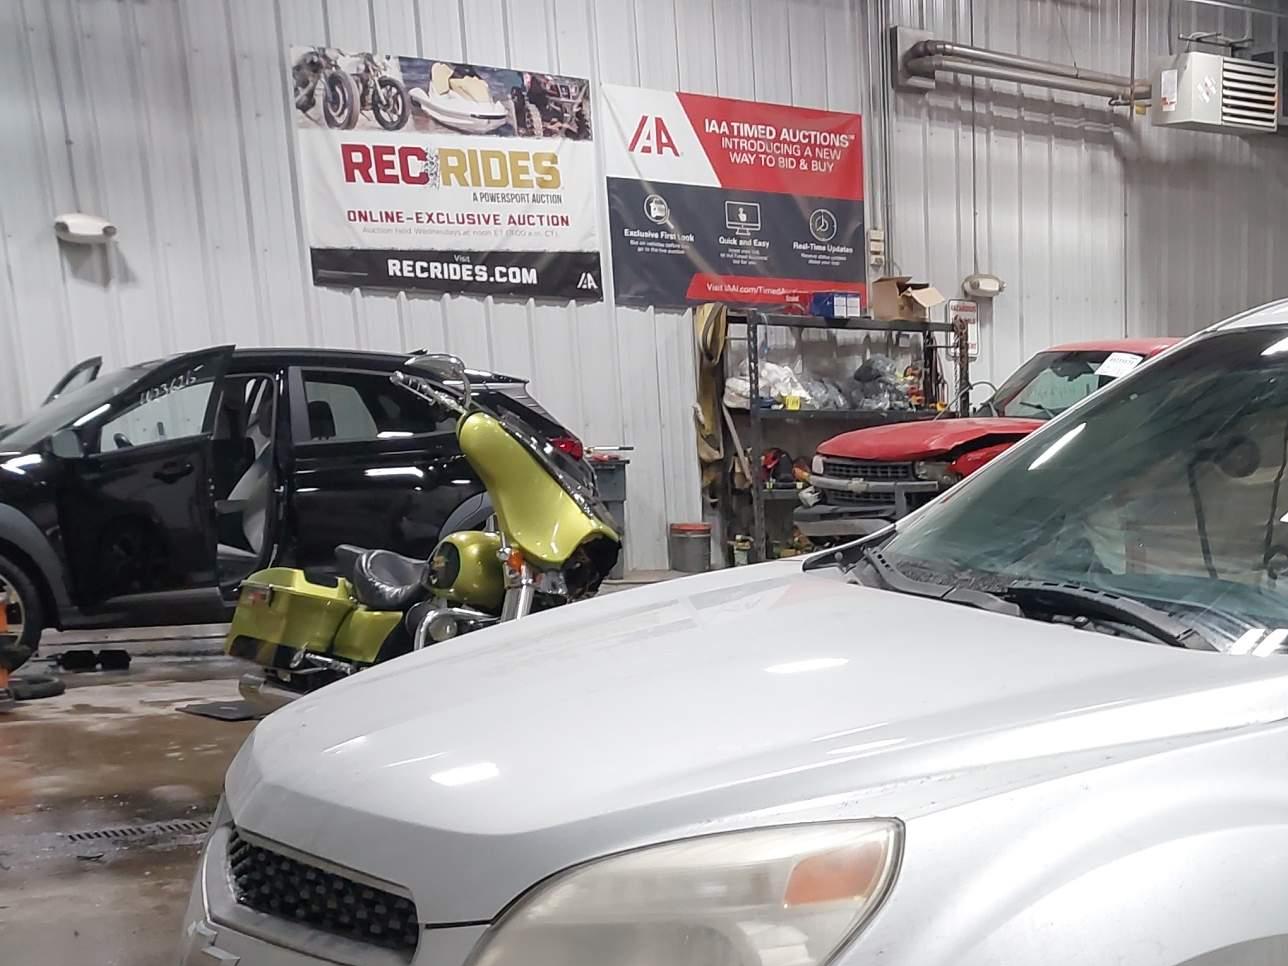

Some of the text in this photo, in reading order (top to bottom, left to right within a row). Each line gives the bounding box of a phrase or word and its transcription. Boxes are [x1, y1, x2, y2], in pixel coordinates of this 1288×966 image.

[704, 118, 729, 135] IAA
[730, 122, 776, 139] TIMED
[721, 137, 842, 160] INTRODUCING A NEW
[341, 144, 561, 190] REC RIDES
[729, 151, 834, 173] WAY TO BID & BUY
[472, 192, 562, 204] A POWERSPORT AUCTION
[347, 210, 570, 227] ONLINE-EXCLUSIVE AUCTION
[624, 228, 659, 239] Exclusive
[660, 231, 676, 240] First
[718, 236, 770, 249] Quick and Easy
[793, 241, 854, 255] Real-Time Updates
[454, 254, 470, 263] Visit
[387, 258, 538, 285] RECRIDES.COM
[706, 282, 723, 292] Visit
